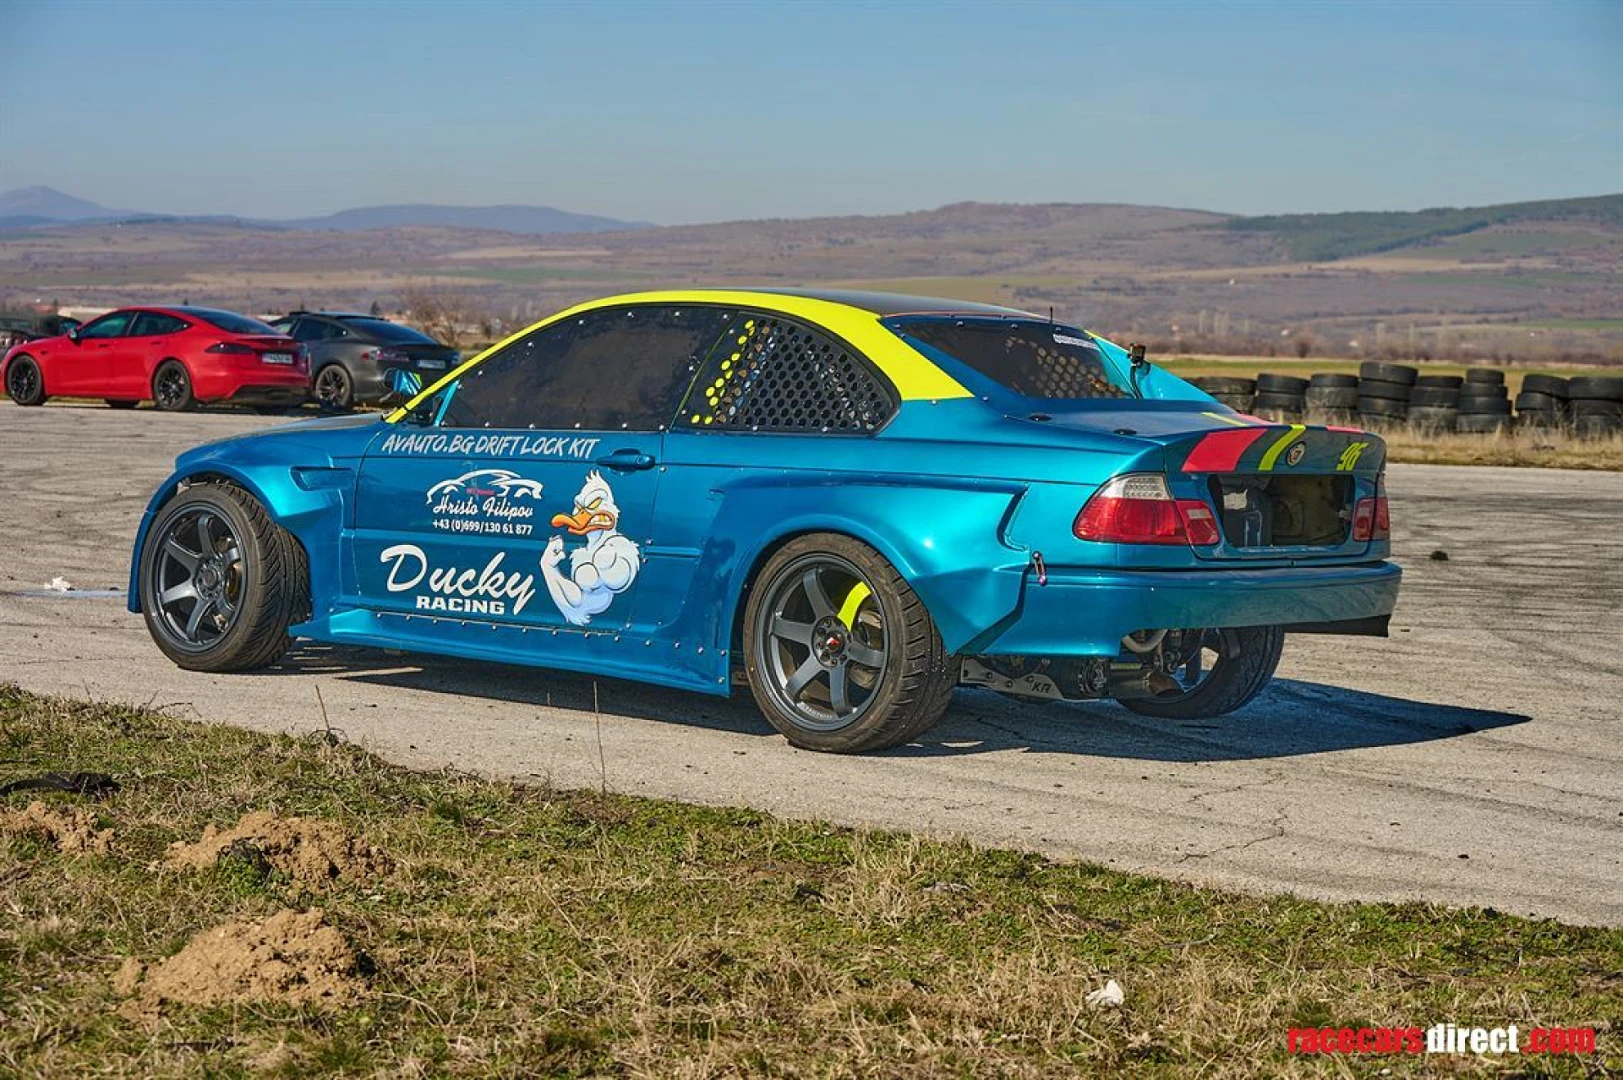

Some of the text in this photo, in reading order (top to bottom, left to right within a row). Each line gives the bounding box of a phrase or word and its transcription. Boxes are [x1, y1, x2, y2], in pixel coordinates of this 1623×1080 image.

[381, 433, 600, 459] AVAUTO.BG DRIFT LOCK KIT
[432, 495, 533, 521] Hristo Filipov
[432, 519, 450, 530] +43
[502, 523, 514, 534] 61
[515, 523, 533, 535] 877
[380, 544, 536, 615] Ducky
[416, 595, 505, 615] RACING
